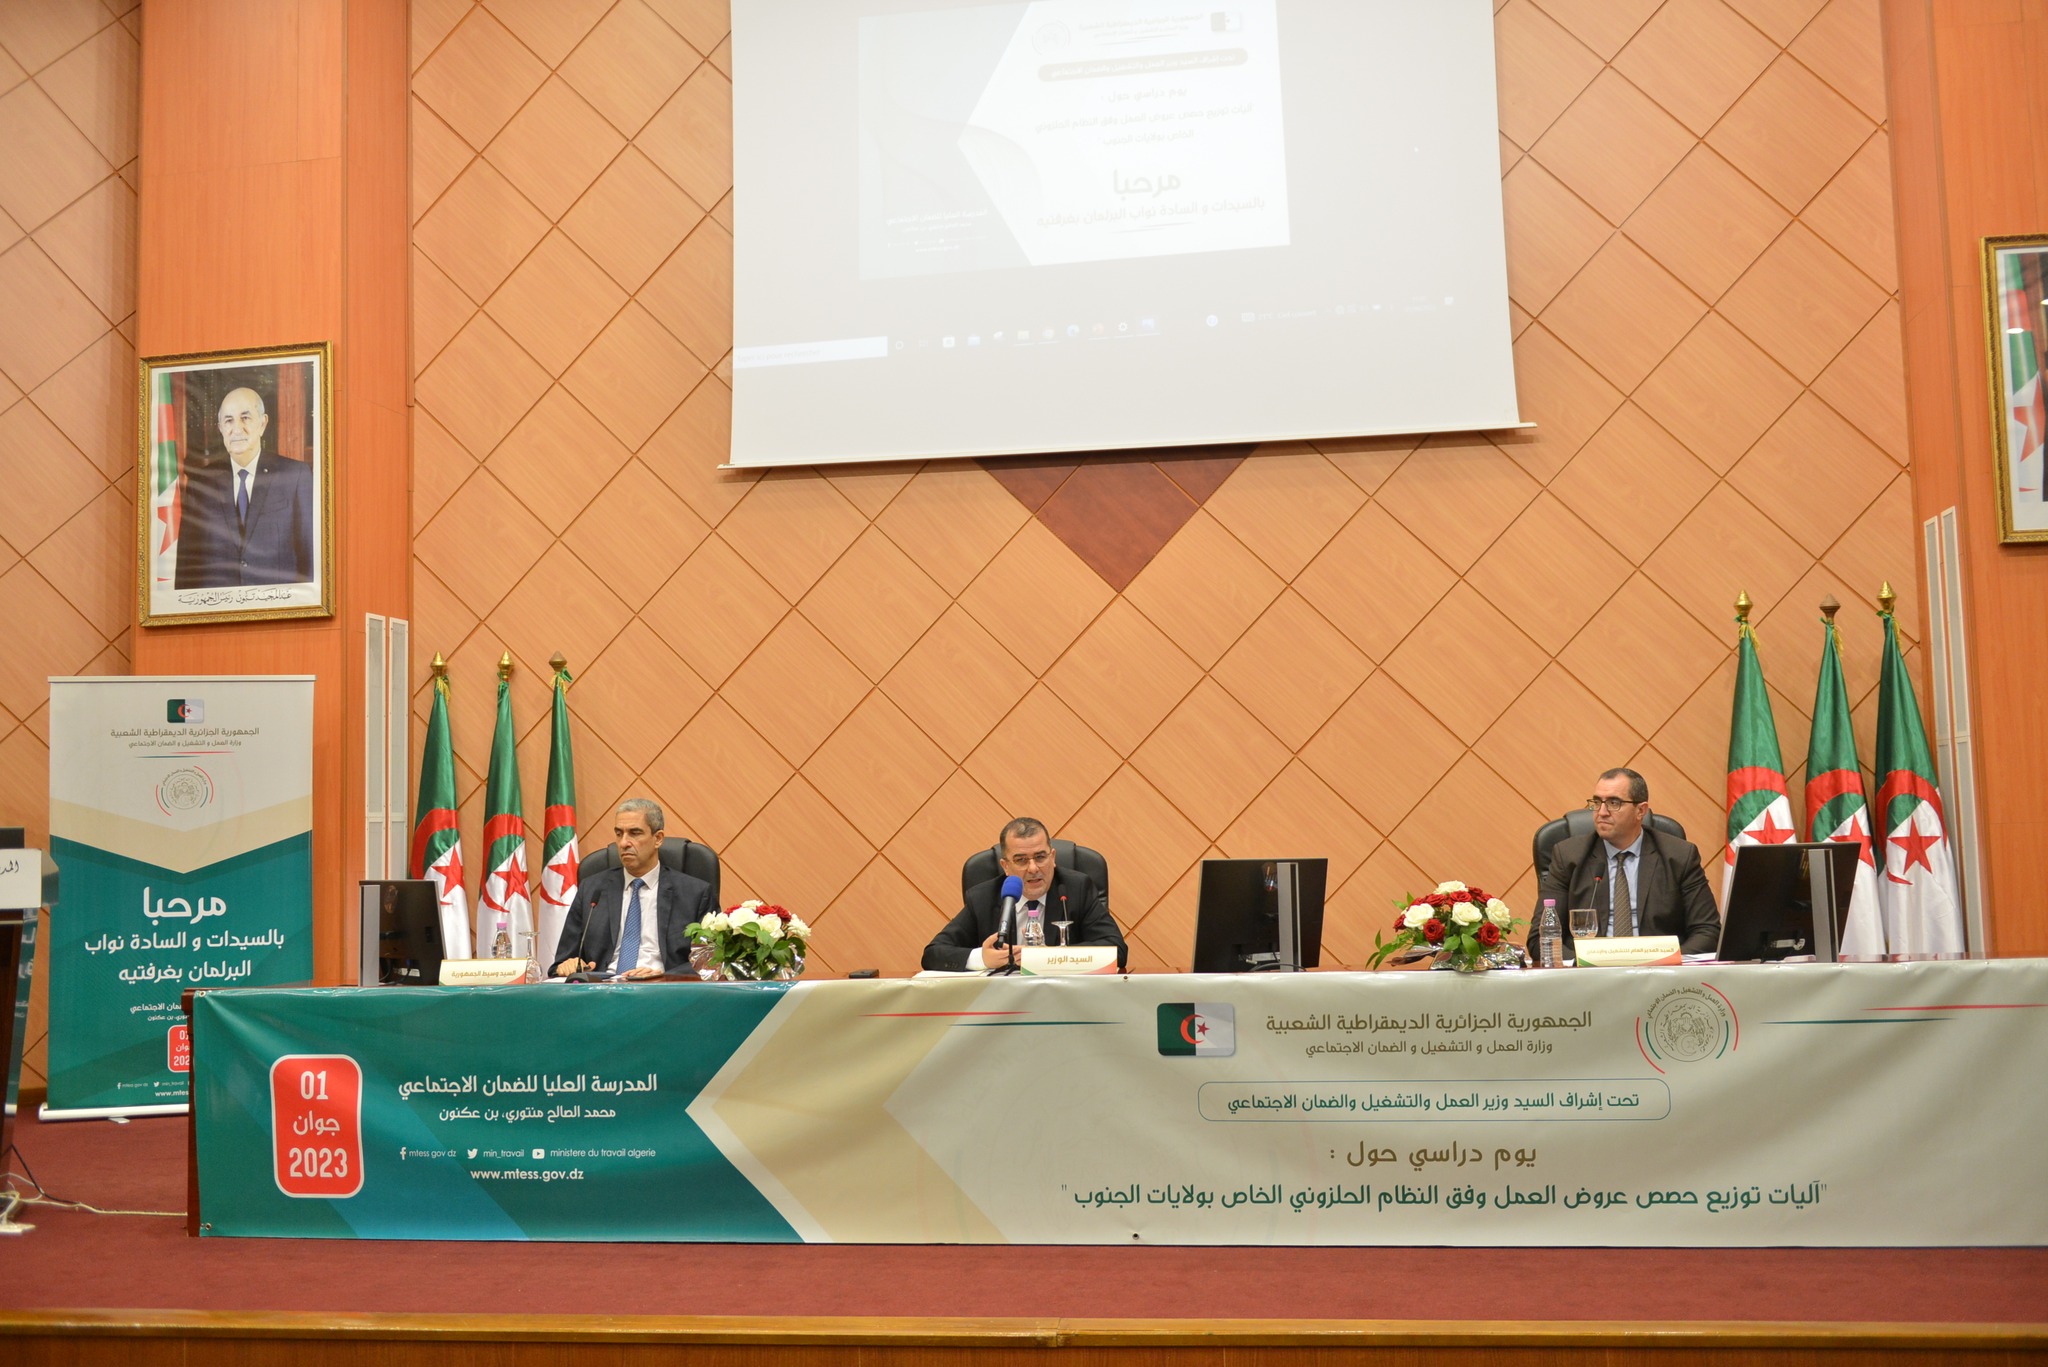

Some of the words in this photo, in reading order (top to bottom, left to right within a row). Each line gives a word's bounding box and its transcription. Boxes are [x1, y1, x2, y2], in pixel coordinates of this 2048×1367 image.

[1113, 168, 1181, 201] مرحبا
[1129, 207, 1157, 220] نواب
[1160, 201, 1199, 216] السادة
[1211, 196, 1265, 214] بالسيدات
[1083, 207, 1127, 225] البرلمان
[111, 729, 141, 738] الشعبية
[144, 728, 186, 737] الديمقراطية
[189, 728, 219, 737] الجزائرية
[222, 728, 259, 736] الجمهورية
[129, 740, 156, 748] الاجتماعي
[143, 886, 226, 926] مرحبا
[85, 934, 124, 955] نواب
[130, 931, 186, 950] السادة
[192, 936, 201, 951] و
[207, 929, 285, 950] بالسيدات
[1047, 956, 1068, 965] الوزير
[119, 963, 182, 984] بغرفتيه
[188, 960, 251, 982] البرلمان
[130, 1003, 165, 1014] الاجتماعي
[1266, 1014, 1331, 1035] الشعبية
[1337, 1013, 1429, 1033] الديمقراطية
[1435, 1012, 1501, 1033] الجزائرية
[1507, 1011, 1592, 1032] الجمهورية
[1305, 1041, 1364, 1058] الاجتماعي
[1367, 1041, 1407, 1055] الضمان
[1411, 1045, 1417, 1055] و
[1420, 1040, 1472, 1055] التشغيل
[1476, 1044, 1482, 1054] و
[1486, 1040, 1523, 1054] العمل
[1527, 1039, 1553, 1053] وزارة
[174, 1055, 190, 1066] 202
[301, 1070, 328, 1100] 01
[398, 1075, 477, 1100] الاجتماعي
[482, 1074, 537, 1096] للضمان
[542, 1074, 586, 1096] العليا
[591, 1073, 657, 1096] المدرسة
[1227, 1094, 1297, 1114] الاجتماعي
[1301, 1094, 1356, 1112] والضمان
[1361, 1093, 1430, 1112] والتشغيل
[1436, 1093, 1479, 1111] العمل
[1482, 1096, 1509, 1111] وزير
[1514, 1092, 1554, 1111] السيد
[1559, 1092, 1603, 1112] إشراف
[1607, 1092, 1640, 1108] تحت
[293, 1110, 340, 1136] جوان
[439, 1106, 480, 1121] عكنون
[484, 1109, 499, 1121] بن
[501, 1107, 544, 1123] منتوري،
[547, 1105, 580, 1123] الصالح
[584, 1109, 616, 1118] محمد
[289, 1147, 348, 1178] 2023
[409, 1149, 430, 1158] mtess
[431, 1151, 446, 1160] gov
[447, 1149, 456, 1157] dz
[483, 1149, 524, 1159] min_travail
[551, 1149, 586, 1157] ministere
[588, 1148, 599, 1157] du
[601, 1148, 626, 1157] travail
[628, 1148, 656, 1159] algerie
[1346, 1141, 1398, 1167] حول
[1409, 1141, 1483, 1172] دراسي
[1494, 1147, 1537, 1171] يوم
[470, 1168, 584, 1182] www.mtess.gov.dz
[1074, 1184, 1140, 1209] الجنوب
[1147, 1184, 1214, 1209] بولايات
[1221, 1184, 1282, 1209] الخاص
[1290, 1184, 1371, 1213] الحلزوني
[1378, 1184, 1438, 1212] النظام
[1446, 1184, 1486, 1209] وفق
[1494, 1184, 1556, 1209] العمل
[1563, 1187, 1628, 1209] عروض
[1636, 1190, 1698, 1209] حصص
[1706, 1186, 1761, 1212] توزيع
